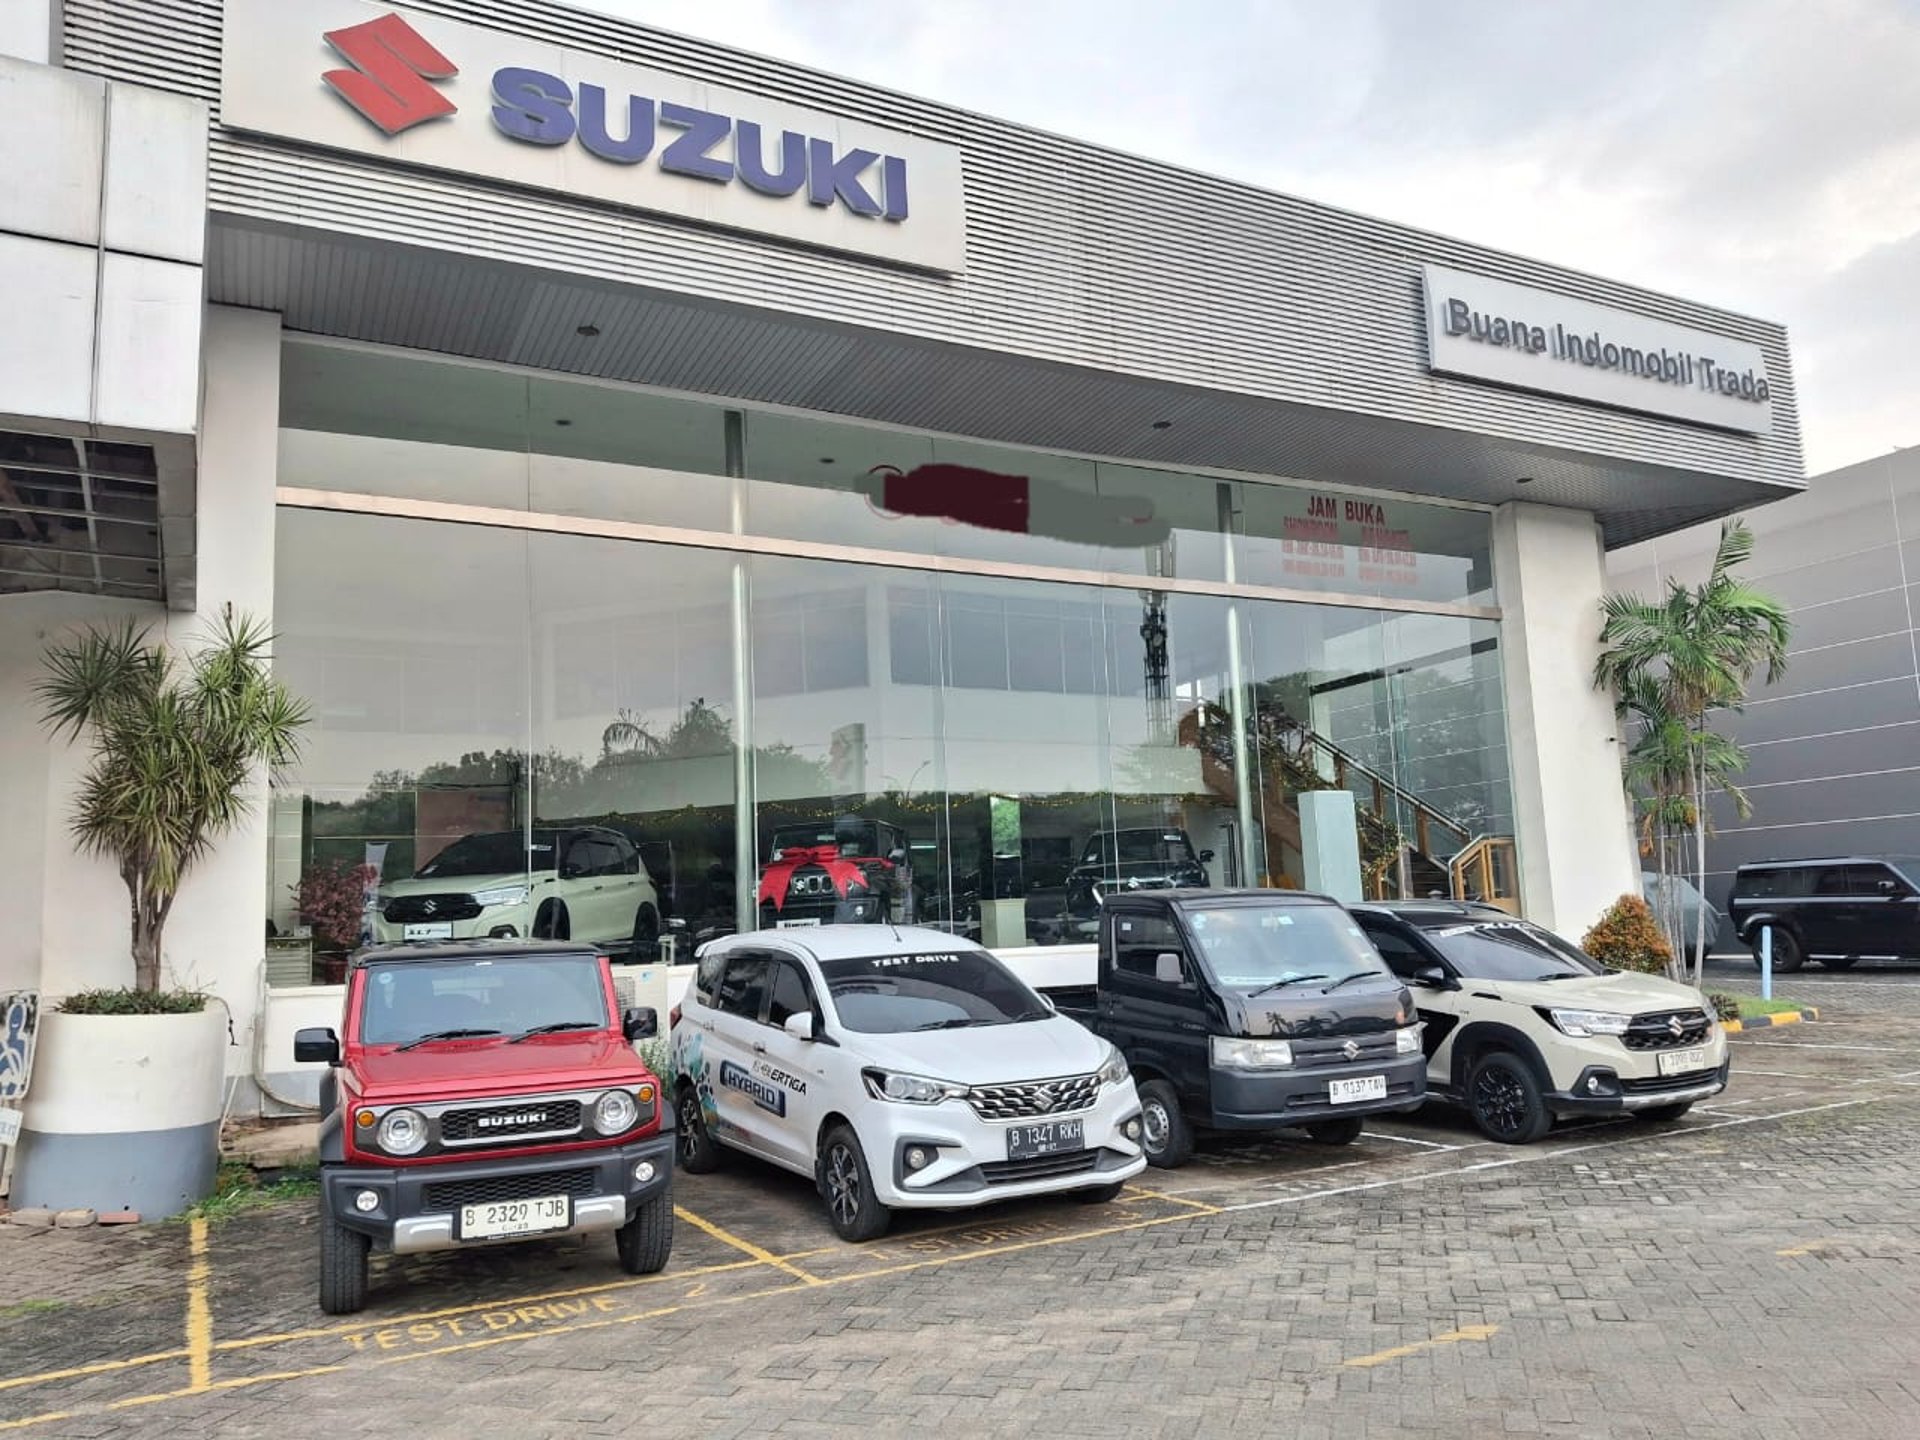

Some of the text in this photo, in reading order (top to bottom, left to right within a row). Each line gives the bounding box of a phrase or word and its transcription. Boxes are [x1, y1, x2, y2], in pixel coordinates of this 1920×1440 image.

[490, 66, 909, 222] SUZUKI
[1446, 298, 1771, 402] Buana Indomobil Trada
[1308, 496, 1385, 525] JAM BUKA
[872, 954, 959, 967] TEST DRIVE
[728, 1069, 776, 1105] HYBRID
[771, 1068, 807, 1096] ERTIGA
[478, 1112, 547, 1127] SUZUKI
[1012, 1130, 1020, 1146] B
[465, 1209, 475, 1226] B
[535, 1199, 565, 1217] TJB
[342, 1318, 464, 1350] TEST
[481, 1295, 632, 1330] DRIVE
